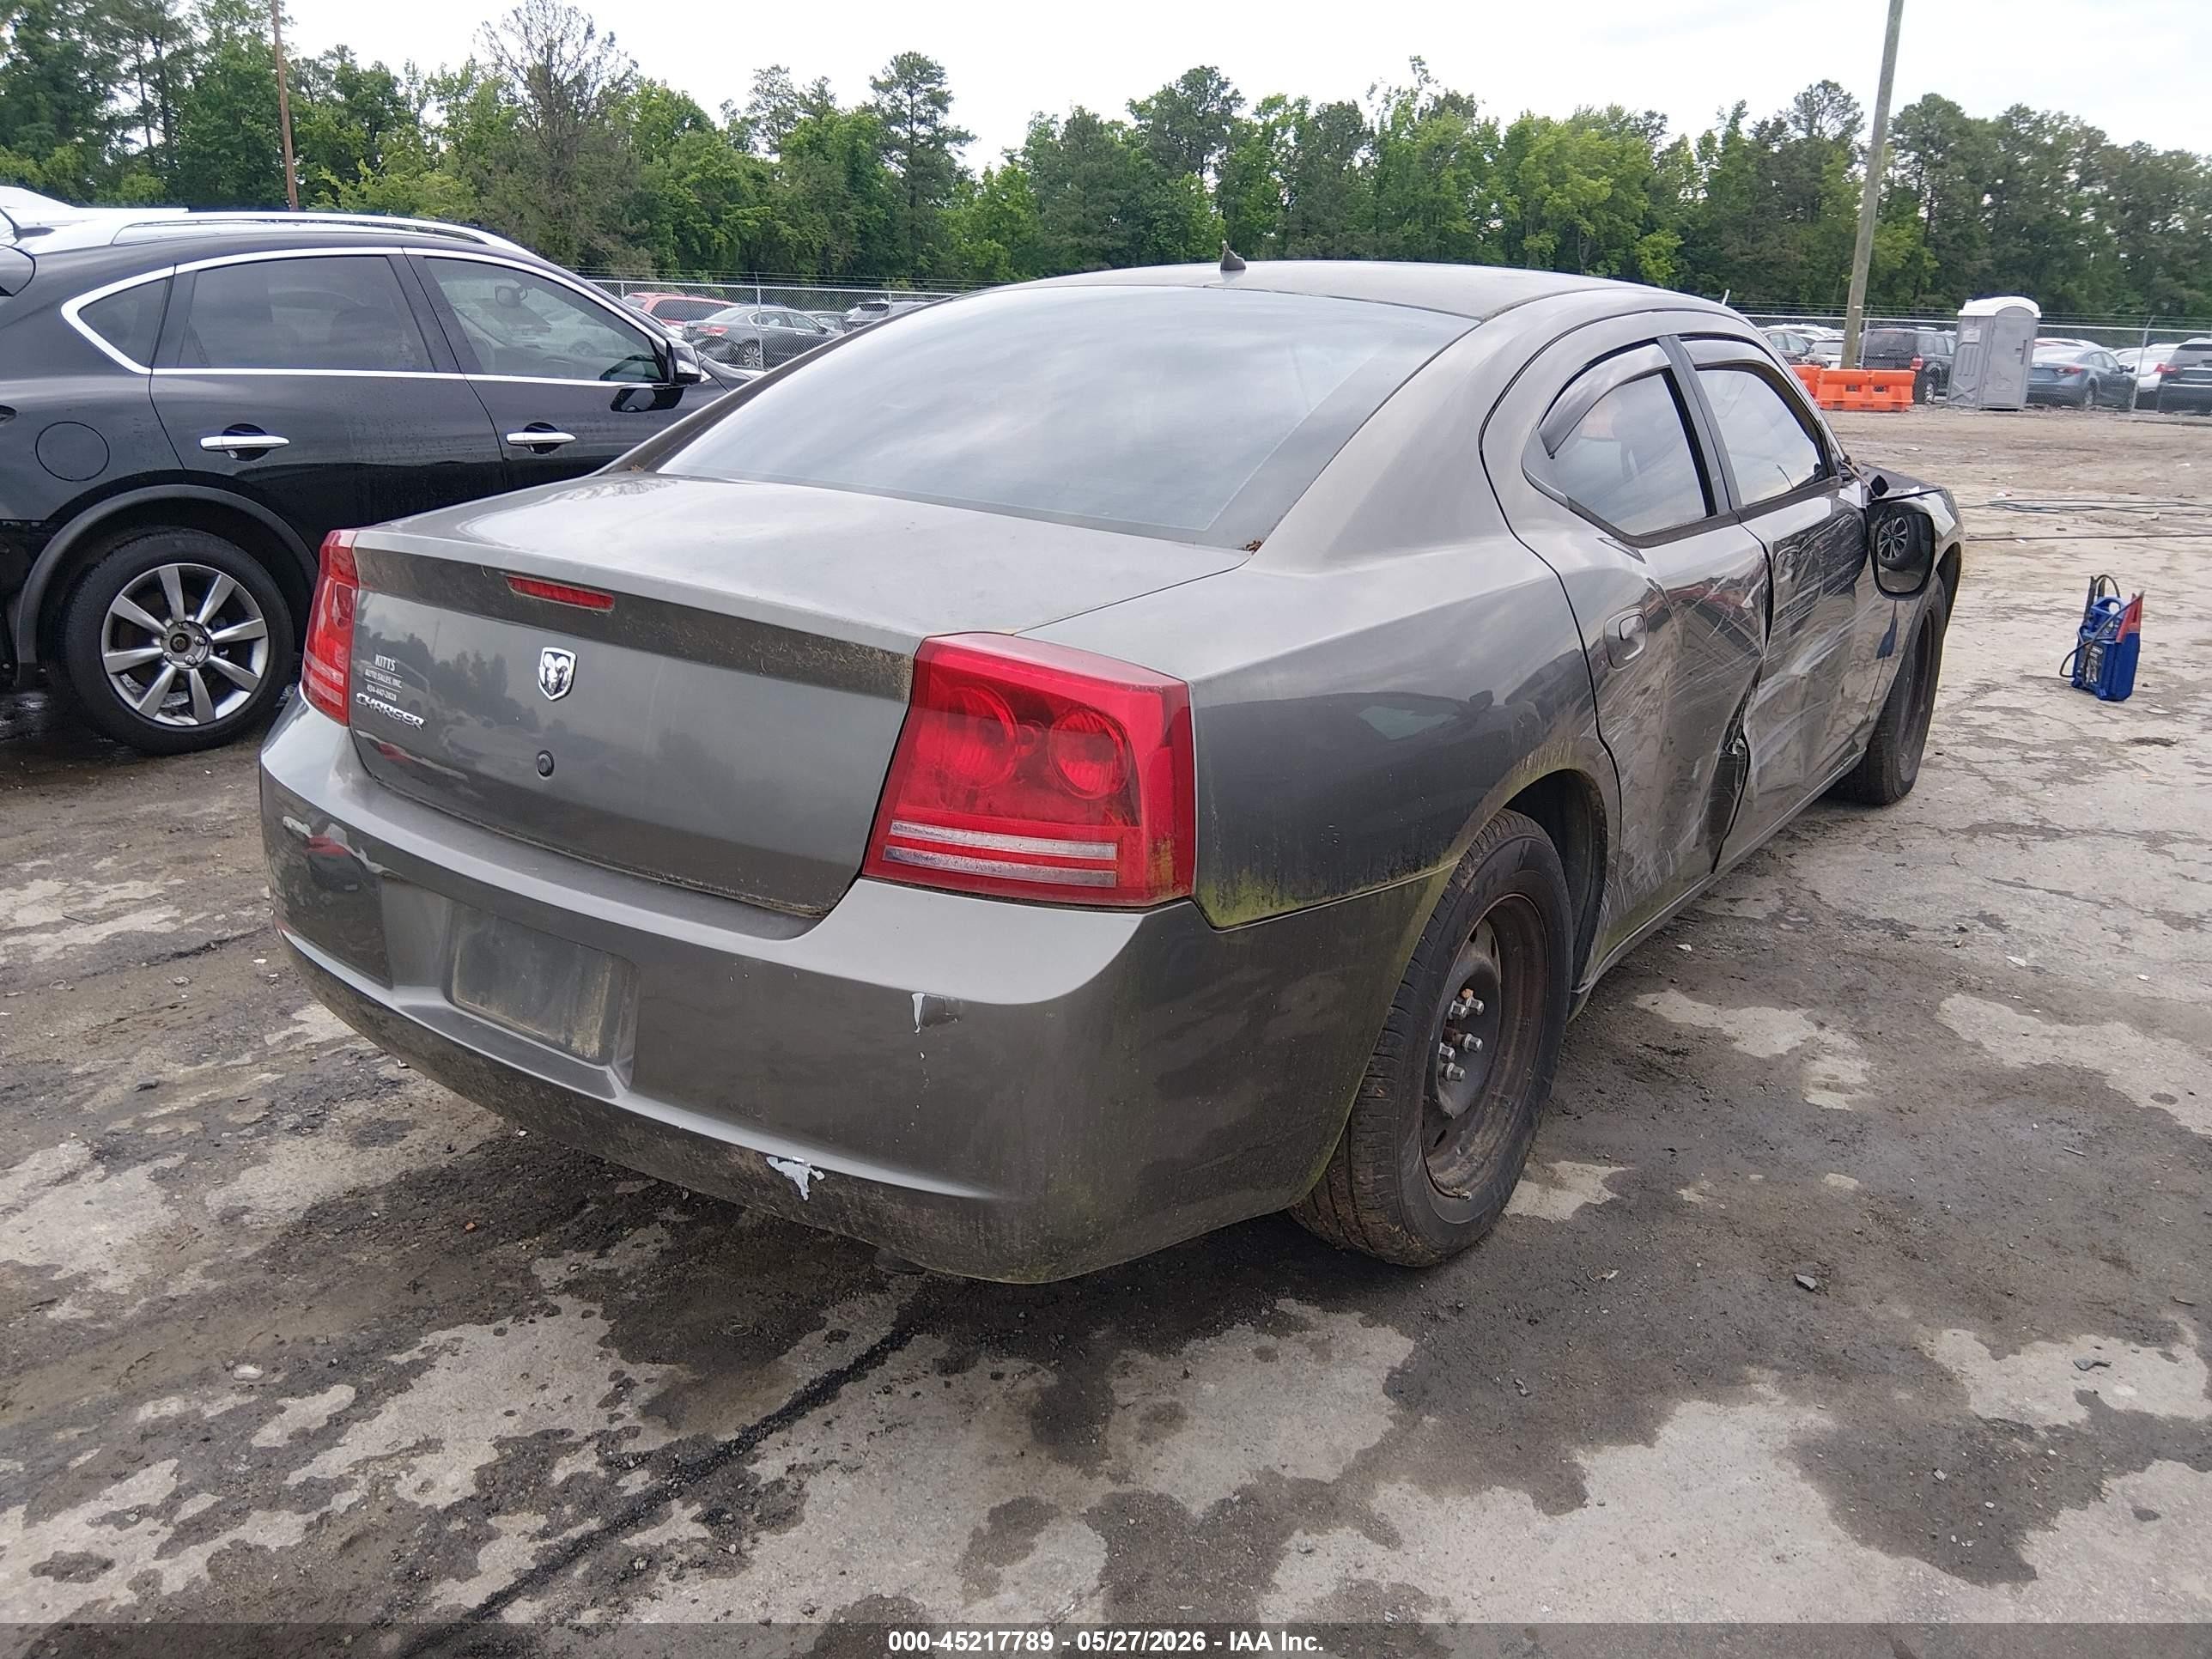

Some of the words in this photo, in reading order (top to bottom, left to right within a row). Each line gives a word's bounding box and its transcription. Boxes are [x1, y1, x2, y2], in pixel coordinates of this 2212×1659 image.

[375, 653, 396, 672] KITTS
[364, 668, 377, 679] AUTO
[356, 692, 425, 731] CHARGER
